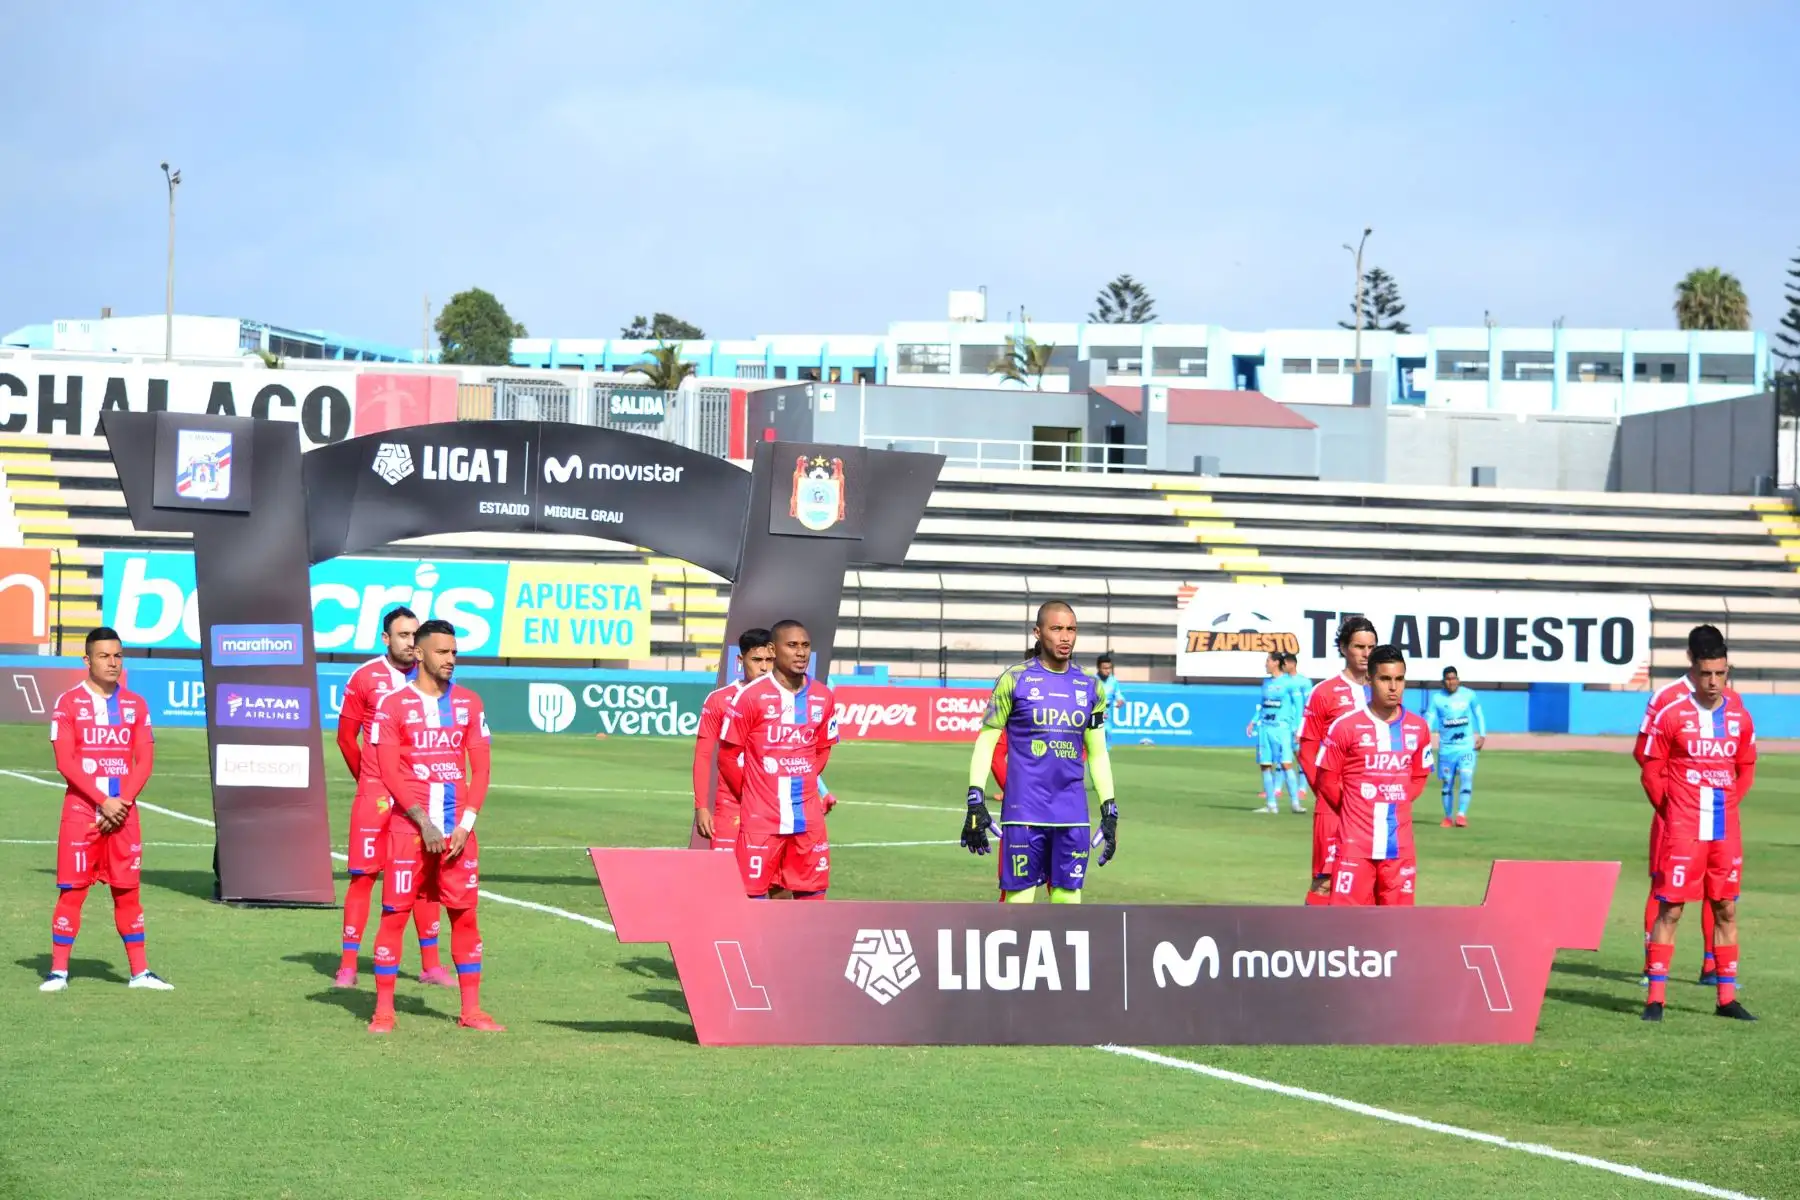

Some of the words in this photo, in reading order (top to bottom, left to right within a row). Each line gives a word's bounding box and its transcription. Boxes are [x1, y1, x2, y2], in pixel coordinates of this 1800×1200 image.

[611, 394, 664, 416] SALIDA
[589, 462, 684, 483] movistar
[479, 501, 529, 516] ESTADIO
[544, 505, 588, 520] MIGUEL
[591, 510, 623, 524] GRAU
[516, 582, 642, 611] APUESTA
[524, 619, 559, 645] EN
[571, 618, 633, 647] VIVO
[1186, 630, 1211, 653] TE
[1211, 632, 1300, 655] APUESTO
[1388, 614, 1634, 665] APUESTO
[222, 637, 293, 652] marathon
[245, 696, 300, 710] LATAM
[582, 683, 668, 709] casa
[245, 711, 300, 720] AIRLINES
[598, 701, 701, 735] verde
[834, 702, 917, 736] anper
[1033, 708, 1086, 727] UPAO
[1112, 700, 1190, 728] UPAO
[83, 727, 131, 745] UPAO
[413, 731, 463, 748] UPAO
[767, 725, 815, 744] UPAO
[1049, 740, 1073, 750] casa
[1687, 740, 1737, 757] UPAO
[99, 757, 124, 767] casa
[224, 757, 302, 774] betsson
[363, 837, 376, 859] 6
[74, 851, 87, 873] 11
[748, 855, 763, 879] 9
[1012, 854, 1029, 877] 12
[395, 870, 413, 894] 10
[1335, 870, 1354, 894] 13
[1232, 945, 1398, 978] movistar
